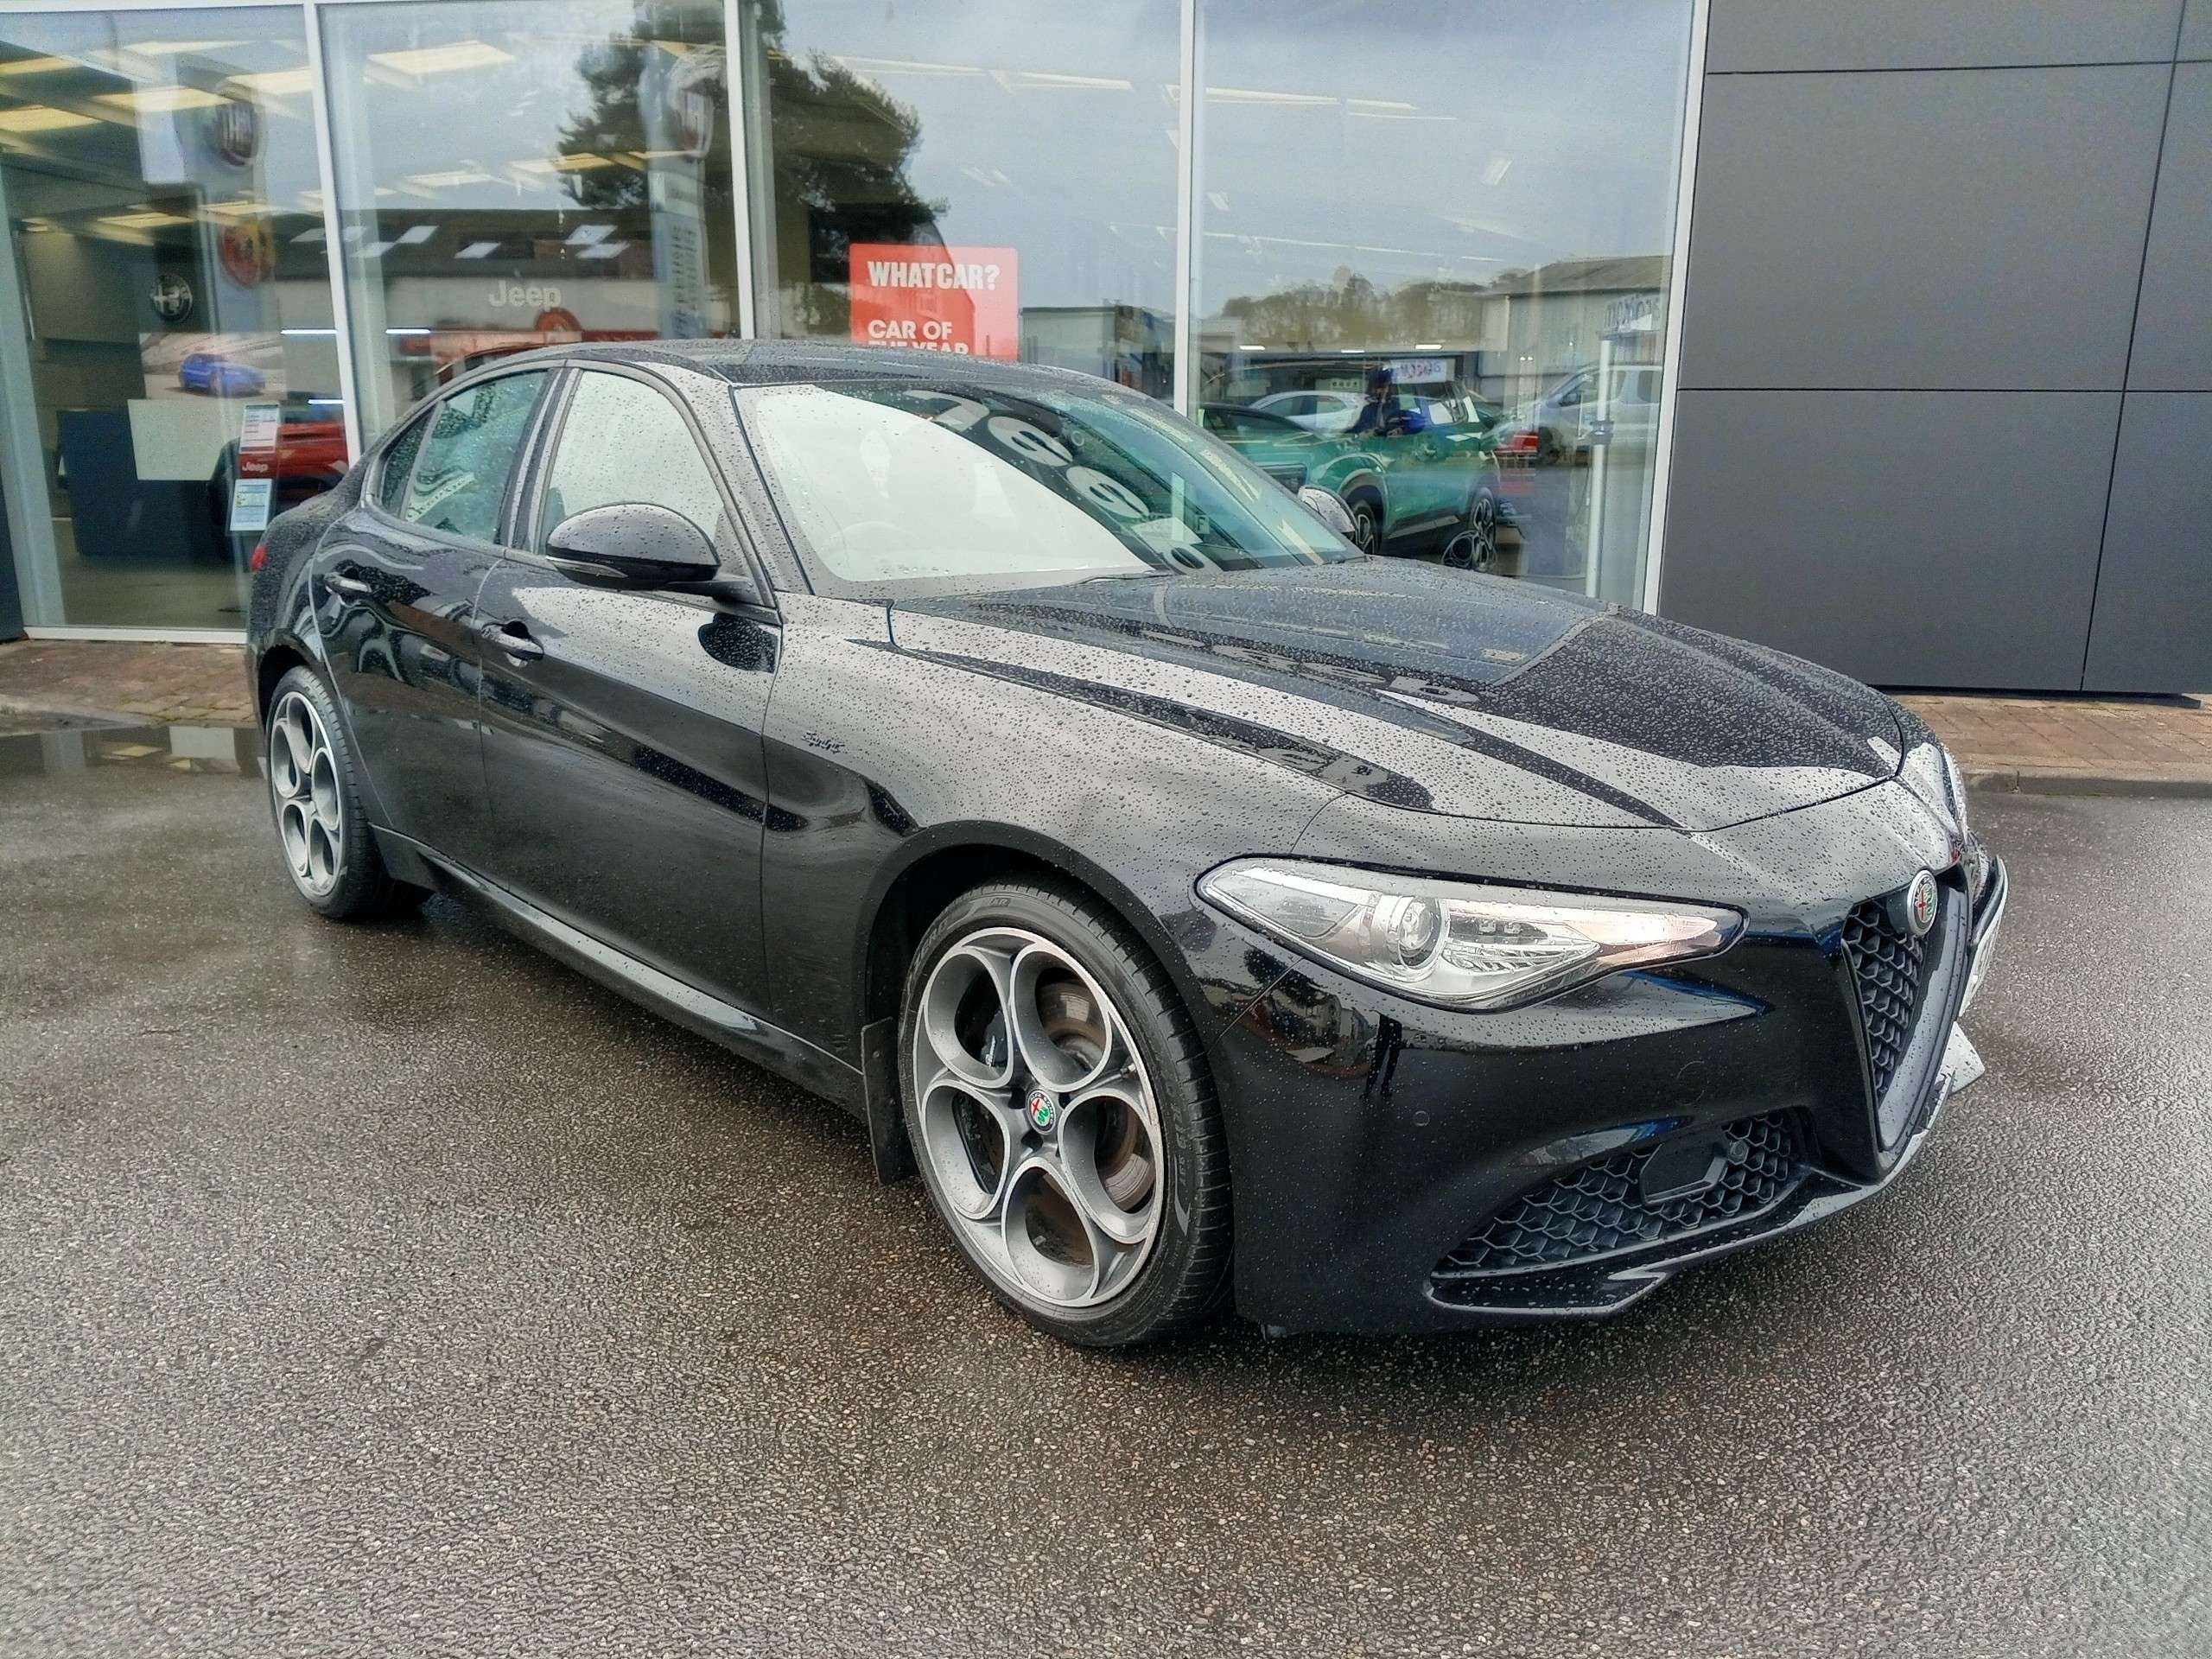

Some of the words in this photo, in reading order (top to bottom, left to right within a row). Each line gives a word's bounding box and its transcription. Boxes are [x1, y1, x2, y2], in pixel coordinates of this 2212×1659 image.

[488, 280, 561, 312] Jeep
[868, 320, 916, 339] CAR
[922, 321, 953, 340] OF
[242, 461, 268, 473] Jeep
